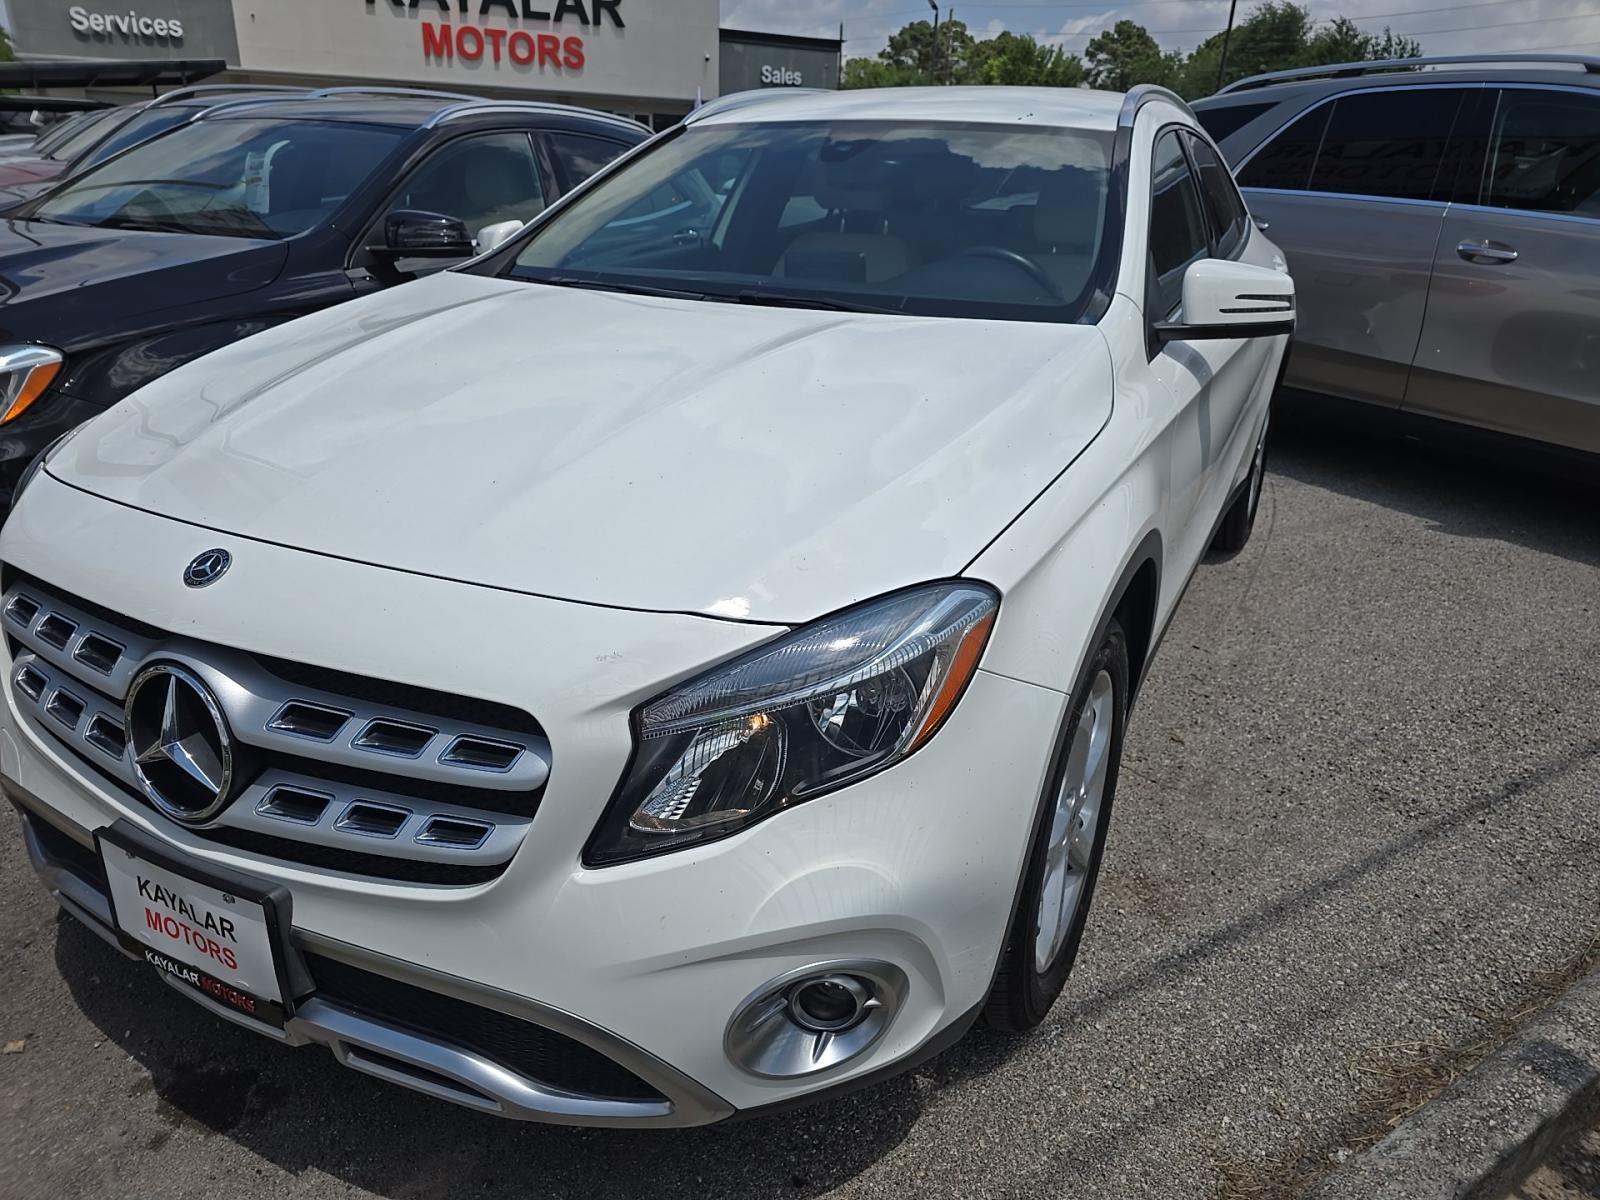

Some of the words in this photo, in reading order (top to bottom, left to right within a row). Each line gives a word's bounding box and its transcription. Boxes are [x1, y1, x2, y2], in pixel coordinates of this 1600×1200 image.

[69, 6, 184, 37] Services
[421, 22, 585, 70] MOTORS
[761, 64, 802, 86] Sales
[136, 875, 237, 943] KAYALAR
[145, 907, 238, 970] MOTORS
[144, 950, 200, 986] KAYALAR
[201, 976, 255, 1013] MOTORS
